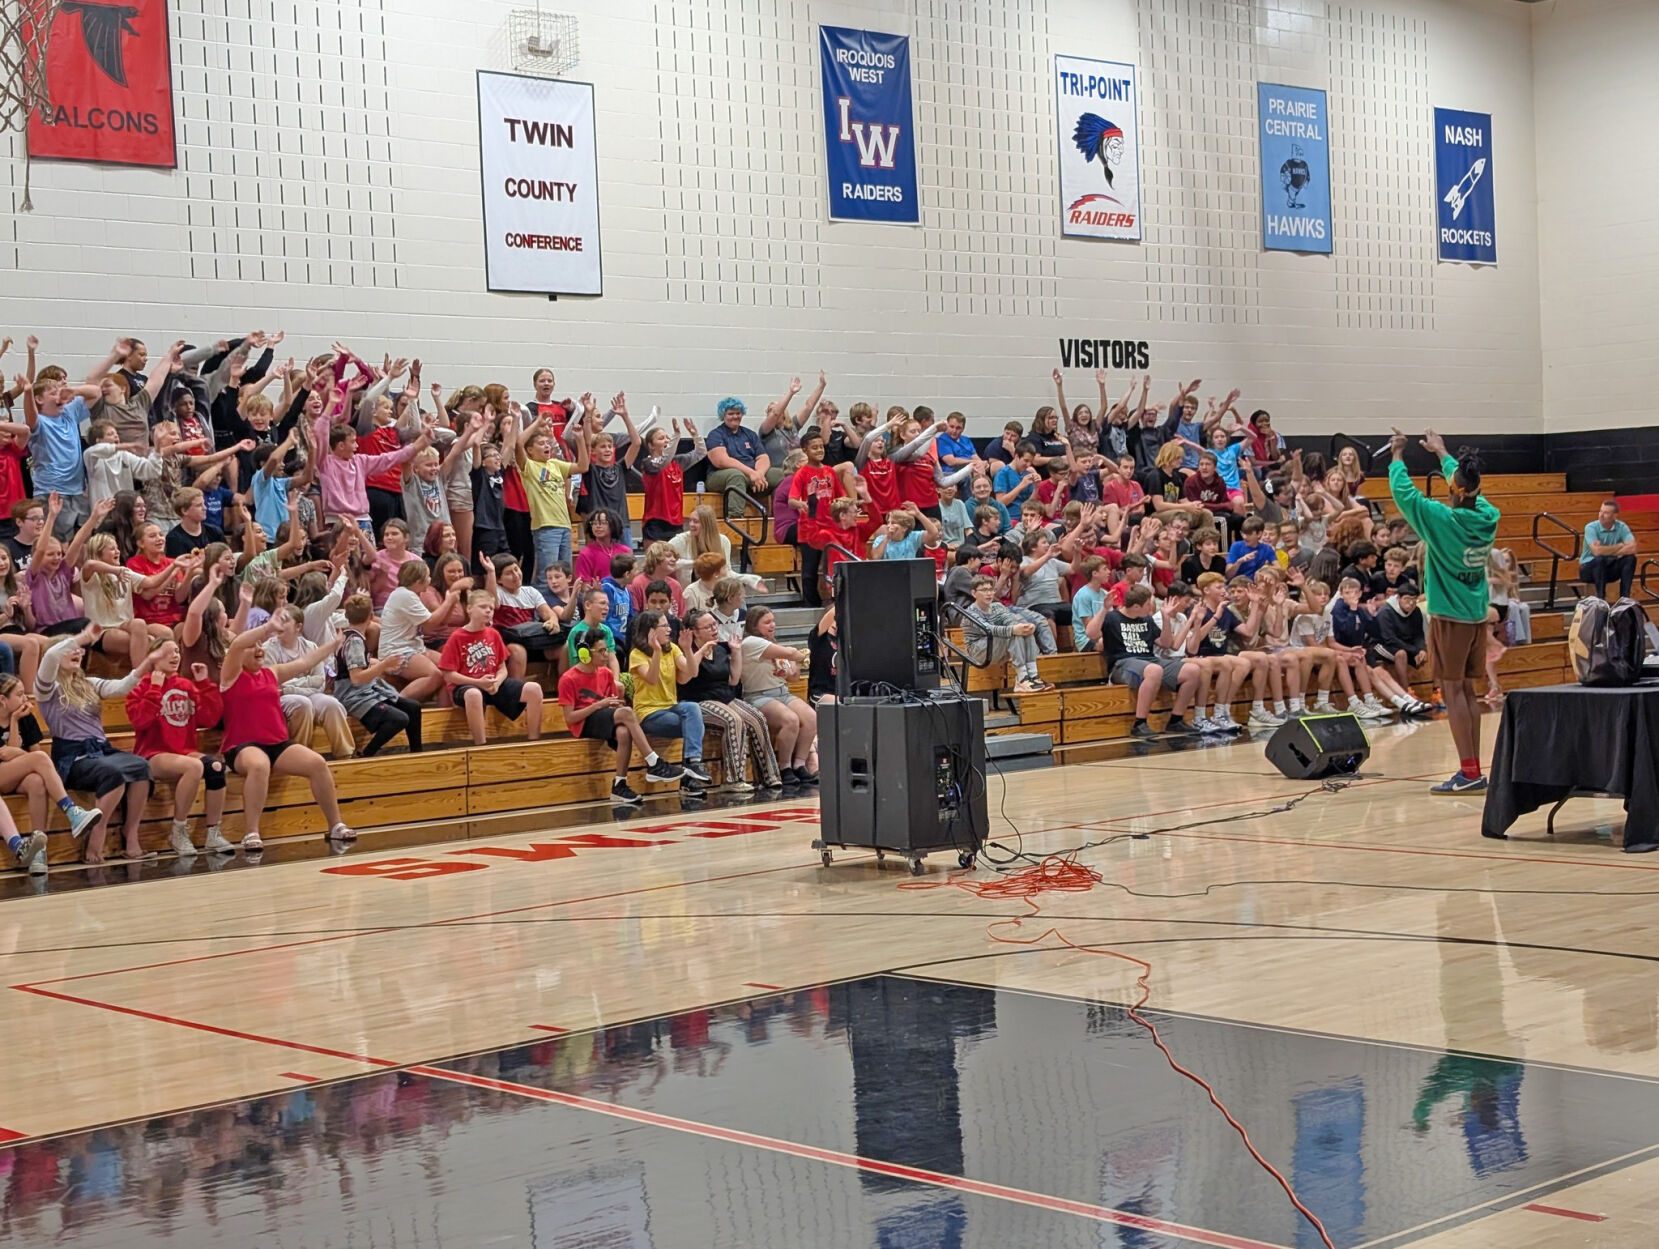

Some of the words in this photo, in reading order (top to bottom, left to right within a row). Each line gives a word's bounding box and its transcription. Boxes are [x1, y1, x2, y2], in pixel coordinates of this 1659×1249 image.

[836, 48, 895, 68] IROQUOIS
[849, 67, 884, 84] WEST
[1060, 72, 1131, 102] TRI-POINT
[1268, 98, 1317, 119] PRAIRIE
[41, 104, 159, 135] ALCONS
[1265, 119, 1322, 140] CENTRAL
[504, 117, 574, 149] TWIN
[1445, 125, 1482, 147] NASH
[504, 178, 577, 202] COUNTY
[842, 183, 903, 202] RAIDERS
[1069, 210, 1136, 228] RAIDERS
[1267, 214, 1325, 239] HAWKS
[505, 232, 583, 252] CONFERENCE
[1441, 228, 1492, 247] ROCKETS
[1059, 339, 1150, 369] VISITORS
[1120, 622, 1149, 633] BASKET
